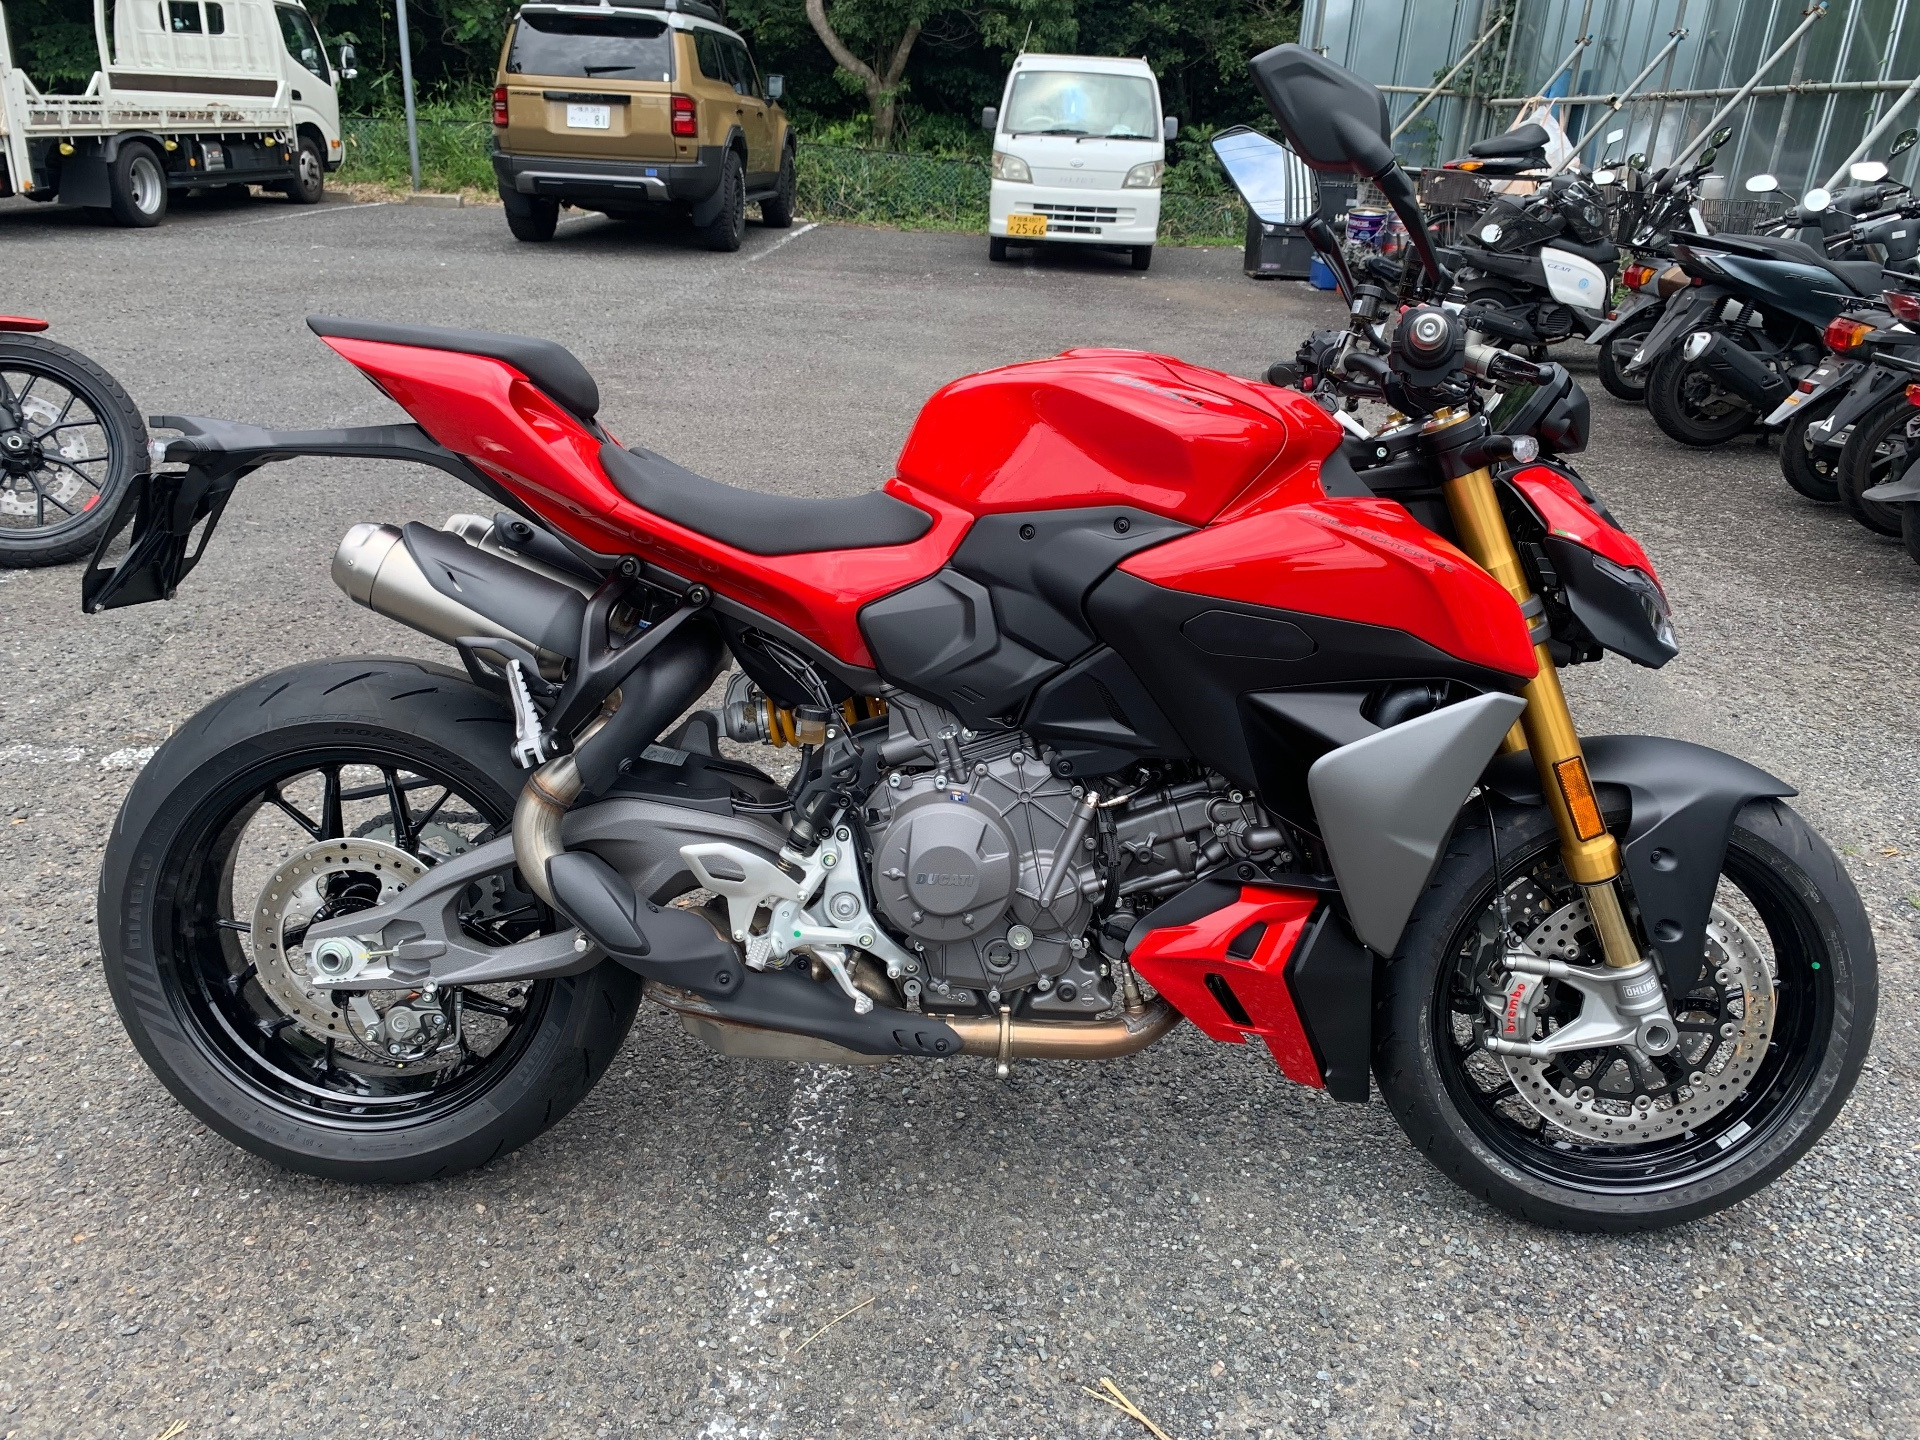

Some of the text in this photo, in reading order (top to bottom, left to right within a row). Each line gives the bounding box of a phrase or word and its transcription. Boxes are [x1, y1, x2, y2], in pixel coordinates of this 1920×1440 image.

[1547, 263, 1571, 273] GEAR
[1111, 376, 1203, 408] DUCATI
[1300, 511, 1424, 559] STREETFIGHTER
[915, 873, 974, 887] DUCATI
[125, 853, 154, 950] DIABLO
[1627, 979, 1656, 996] ÖHLINS
[1504, 983, 1526, 1034] brembo
